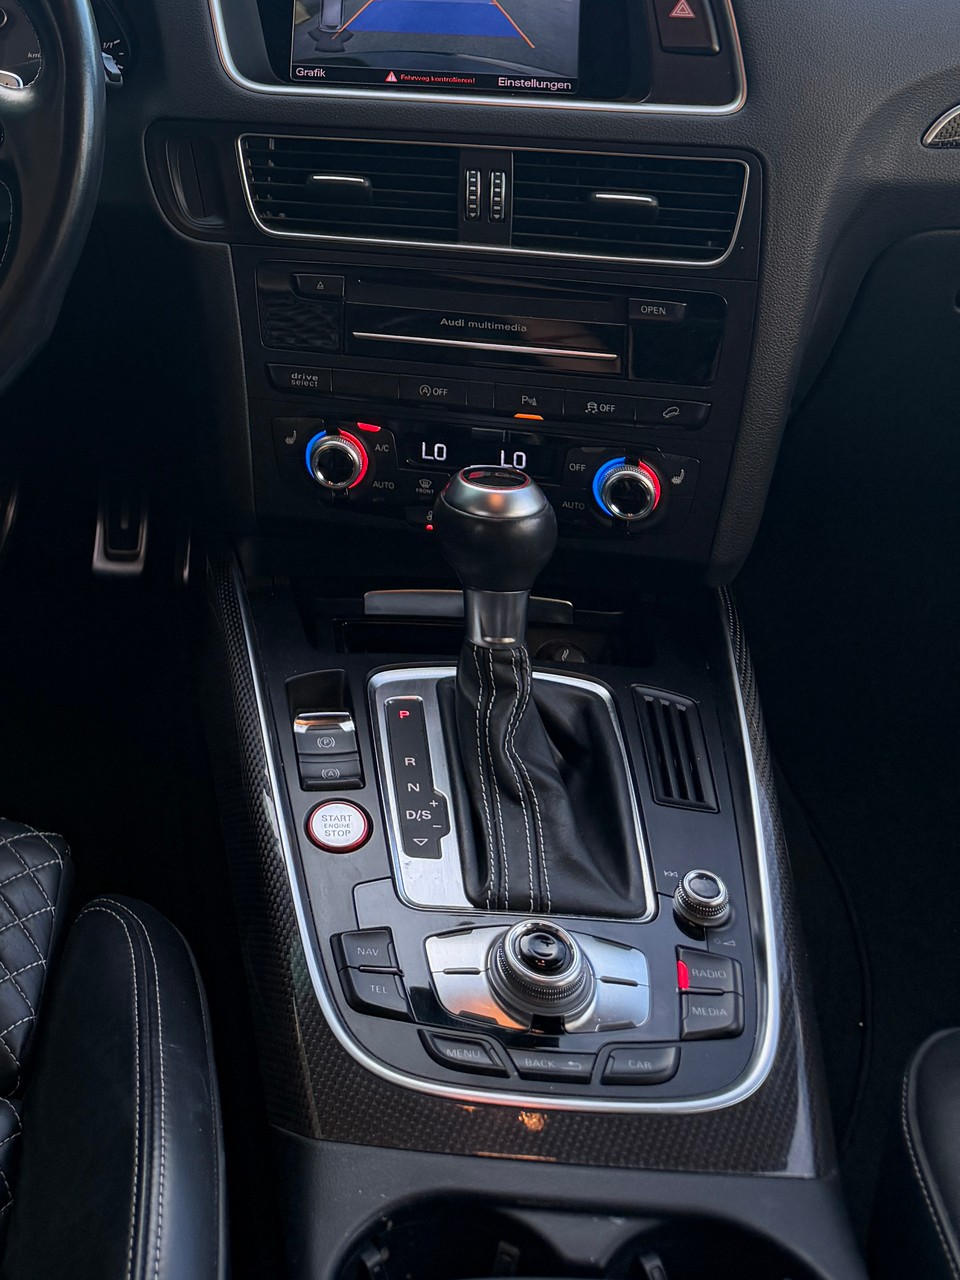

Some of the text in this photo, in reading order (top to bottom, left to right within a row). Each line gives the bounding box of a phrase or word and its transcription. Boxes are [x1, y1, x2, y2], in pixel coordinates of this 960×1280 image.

[103, 41, 115, 49] 1/1
[295, 67, 326, 78] Grafik
[498, 76, 572, 91] Einstellungen
[640, 305, 666, 315] OPEN
[440, 318, 528, 333] Audi multimedia
[291, 372, 319, 381] drive
[291, 379, 318, 388] select
[432, 387, 449, 397] OFF
[599, 404, 616, 413] OFF
[374, 444, 390, 452] A/C
[421, 441, 447, 461] LO
[500, 449, 527, 469] LO
[568, 463, 586, 472] OFF
[372, 481, 395, 490] AUTO
[562, 500, 585, 510] AUTO
[399, 710, 410, 719] P
[404, 757, 416, 766] R
[408, 783, 420, 792] N
[321, 814, 353, 823] START
[324, 829, 352, 837] STOP
[357, 947, 379, 957] NAV
[691, 968, 726, 979] RADIO
[370, 984, 388, 994] TEL
[691, 1006, 728, 1016] MEDIA
[446, 1048, 481, 1058] MENU
[524, 1058, 555, 1068] BACK
[628, 1059, 652, 1070] CAR
